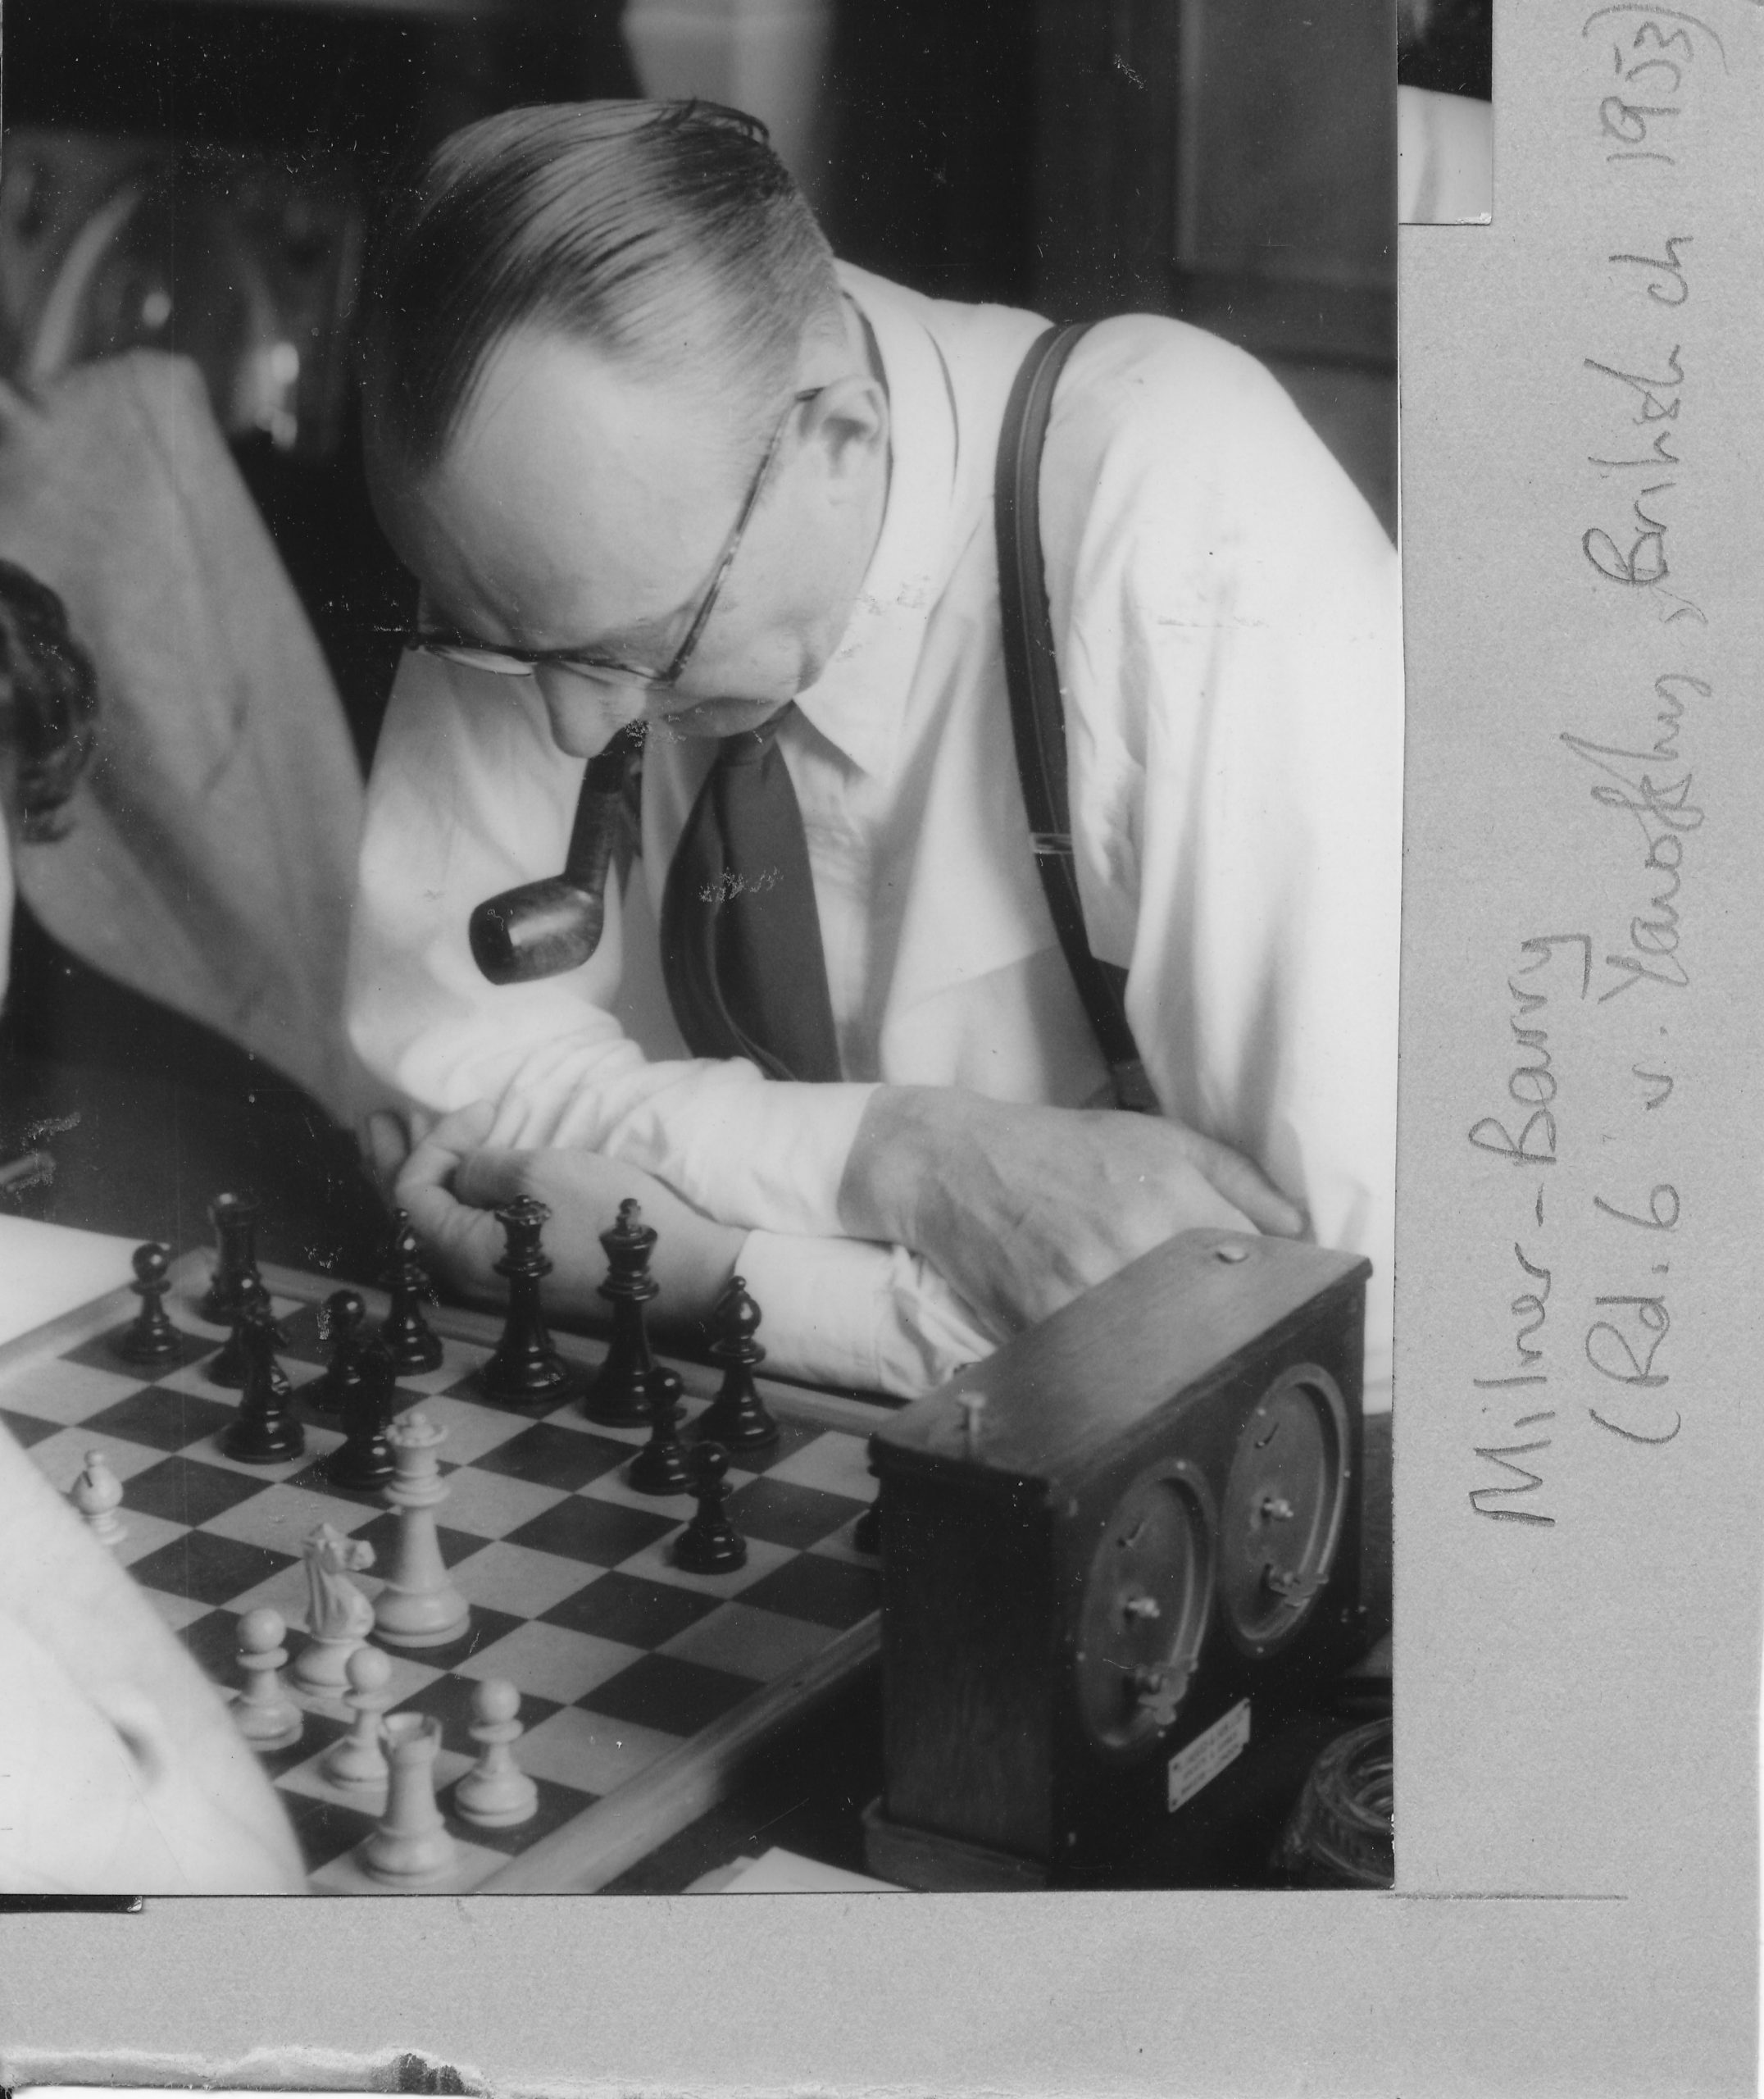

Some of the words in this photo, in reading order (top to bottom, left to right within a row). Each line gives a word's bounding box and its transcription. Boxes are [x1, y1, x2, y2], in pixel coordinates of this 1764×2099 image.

[1581, 2, 1730, 163] 1953)
[1631, 1026, 1674, 1110] v.
[1593, 1182, 1680, 1231] 6
[1584, 1261, 1681, 1444] (Rd.
